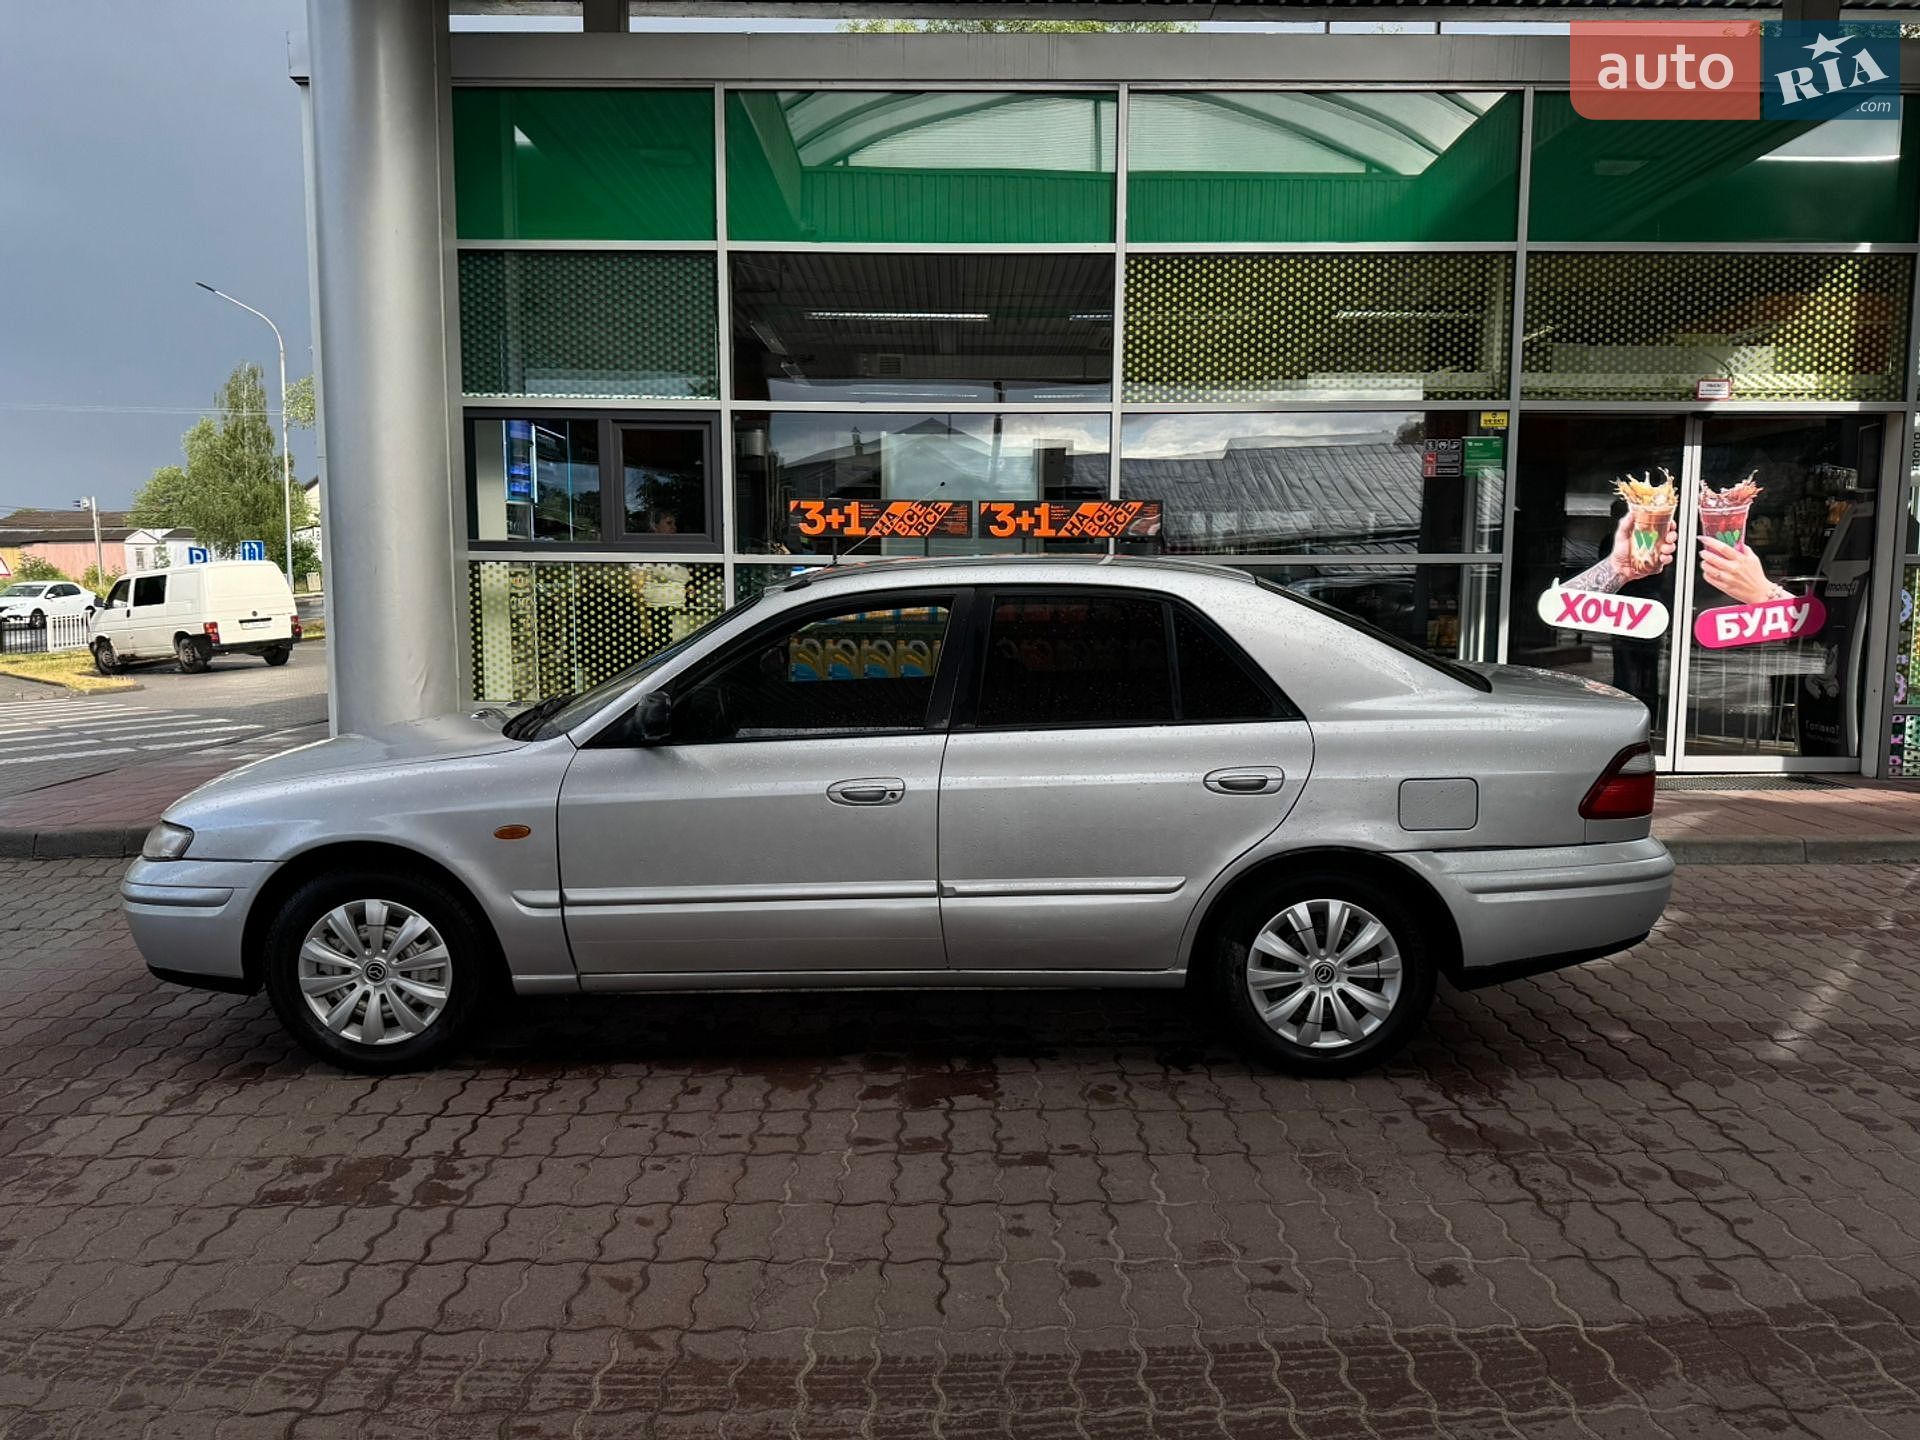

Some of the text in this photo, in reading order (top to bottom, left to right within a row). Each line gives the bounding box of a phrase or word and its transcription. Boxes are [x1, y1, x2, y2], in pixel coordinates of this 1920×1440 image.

[800, 501, 867, 536] 3+1
[989, 502, 1056, 537] 3+1
[1064, 511, 1090, 536] НА
[1085, 502, 1117, 536] ВСЕ
[1104, 502, 1137, 536] ВСЕ
[1556, 592, 1653, 630] ХОЧУ
[1715, 603, 1810, 642] БУДУ
